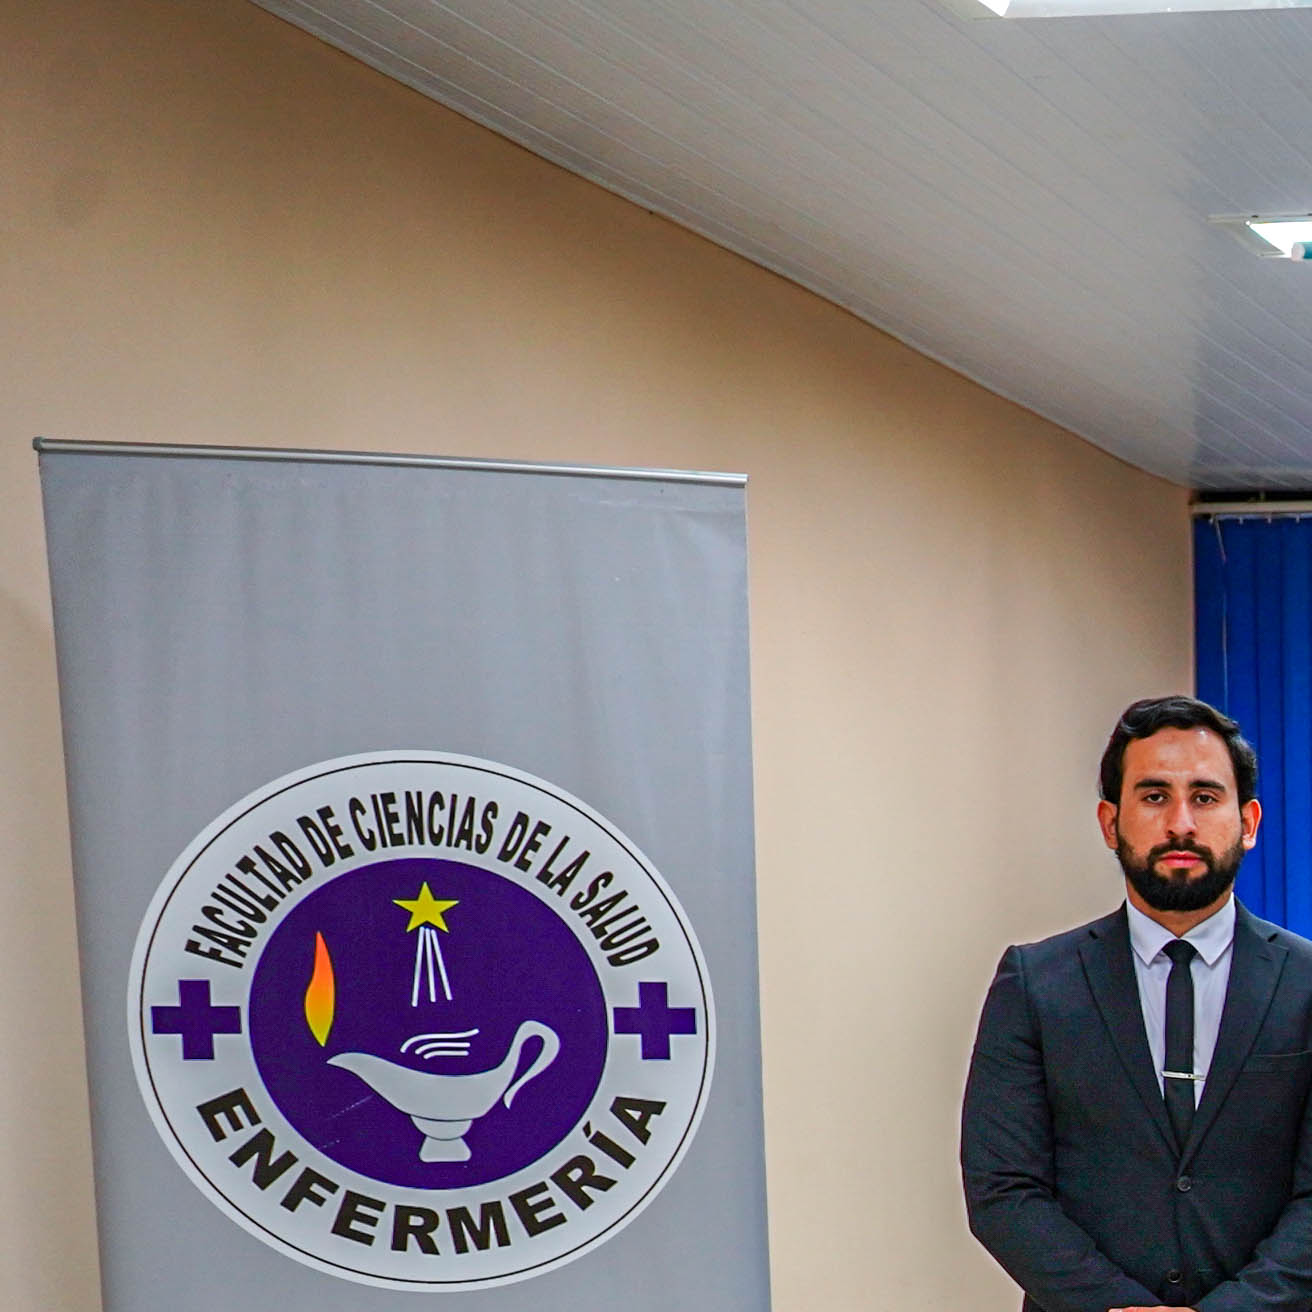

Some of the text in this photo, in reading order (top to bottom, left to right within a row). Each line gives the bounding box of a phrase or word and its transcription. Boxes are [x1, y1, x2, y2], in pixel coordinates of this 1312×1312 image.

[184, 790, 660, 969] FACULTAD DE CIENCIAS DE LA SALUD
[196, 1086, 666, 1256] ENFERMERÍA
